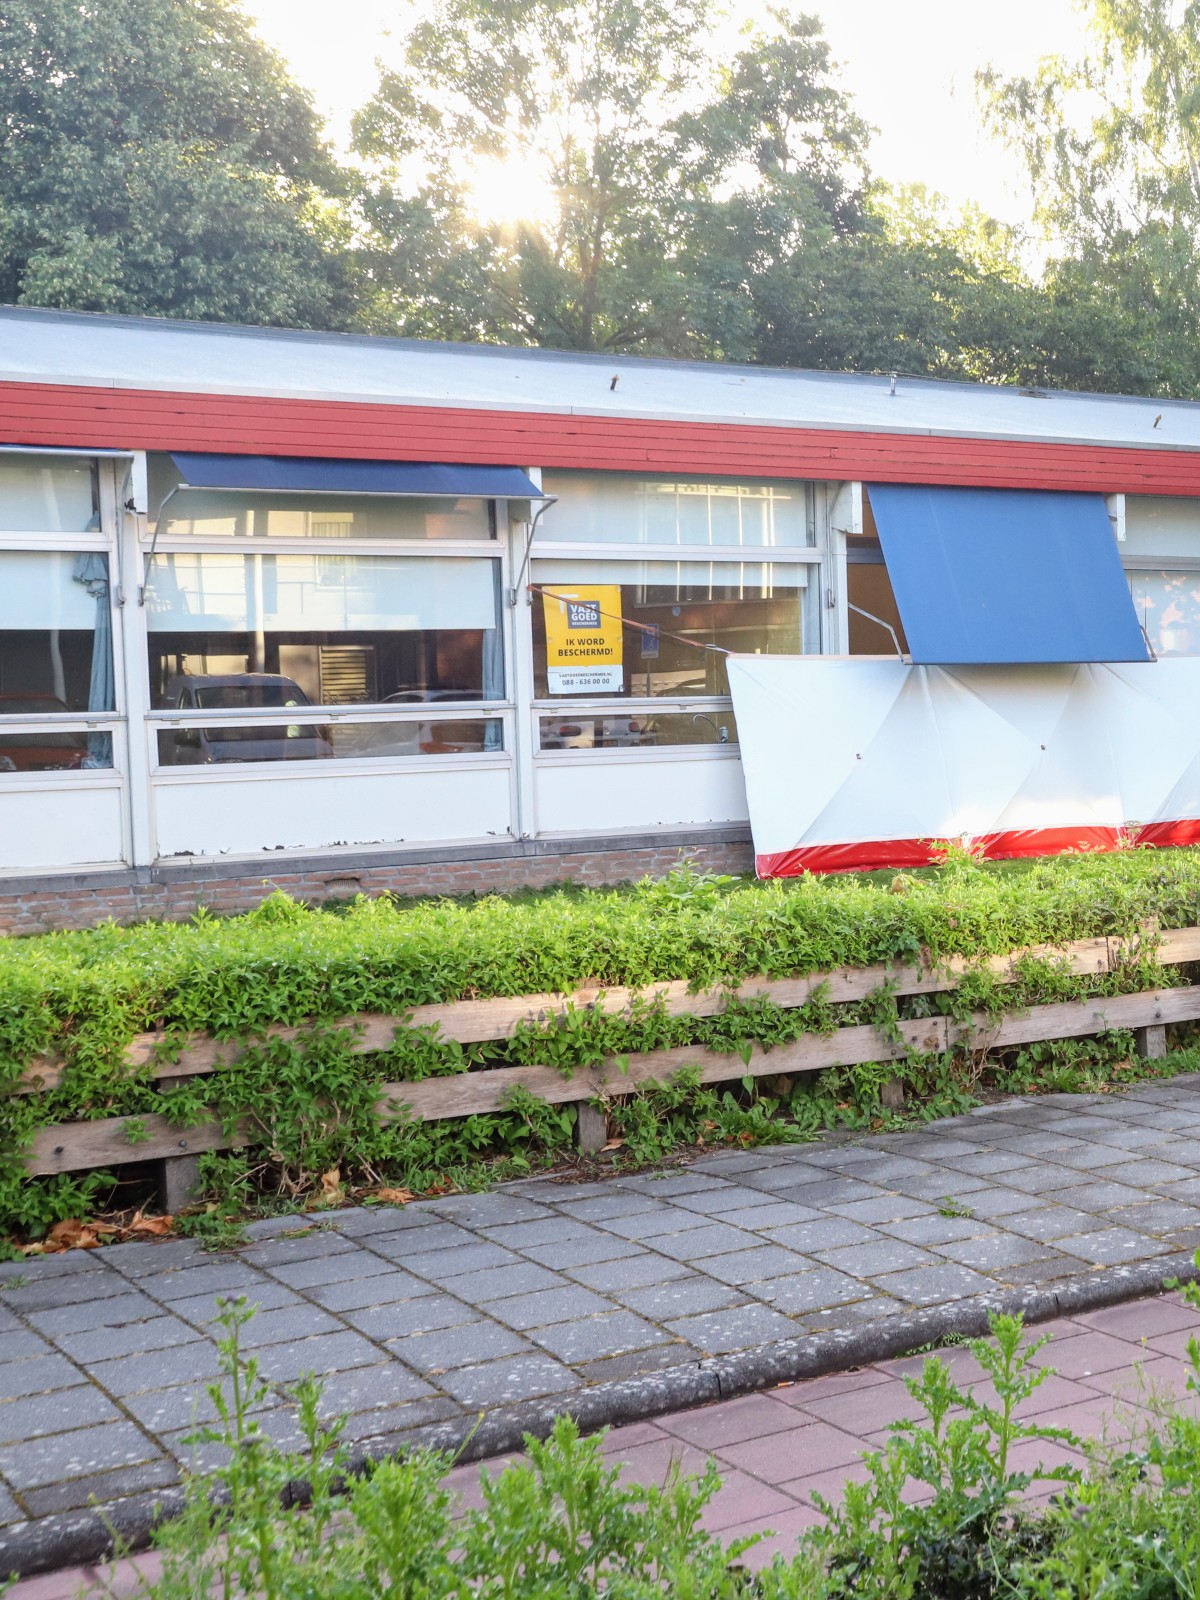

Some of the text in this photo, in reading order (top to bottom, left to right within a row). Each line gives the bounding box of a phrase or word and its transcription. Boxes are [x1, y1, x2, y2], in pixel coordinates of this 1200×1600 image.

[570, 604, 597, 613] VAST
[571, 613, 597, 621] GOED
[558, 648, 613, 656] BESCHERMD!
